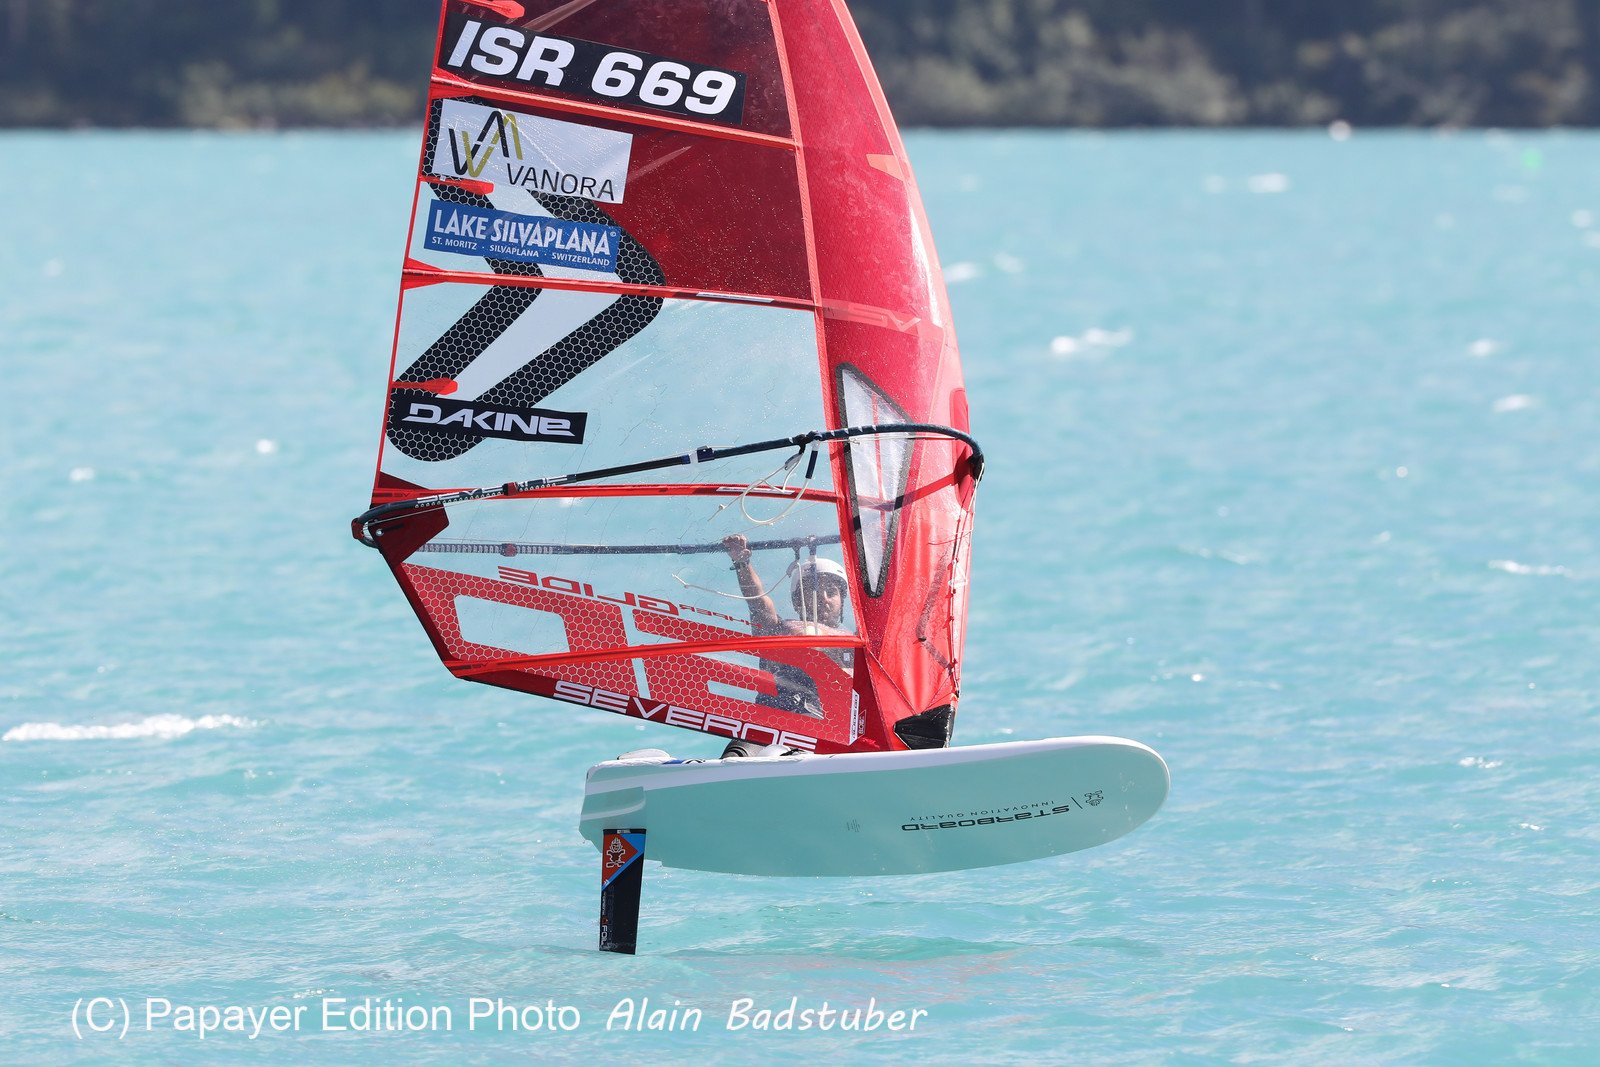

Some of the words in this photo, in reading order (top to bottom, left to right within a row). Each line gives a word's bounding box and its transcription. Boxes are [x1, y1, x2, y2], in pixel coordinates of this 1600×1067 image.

[447, 20, 575, 87] ISR
[591, 51, 737, 115] 669
[507, 163, 615, 201] VANORA
[433, 209, 488, 239] LAKE
[431, 236, 443, 246] ST.
[445, 239, 477, 251] MORITZ
[489, 244, 539, 258] SILVAPLANA
[551, 252, 610, 267] SWITZERLAND
[401, 402, 576, 437] DAKINE
[553, 680, 818, 754] SEVERNE
[910, 812, 965, 822] QUALITY
[970, 800, 1055, 817] INNOVATION
